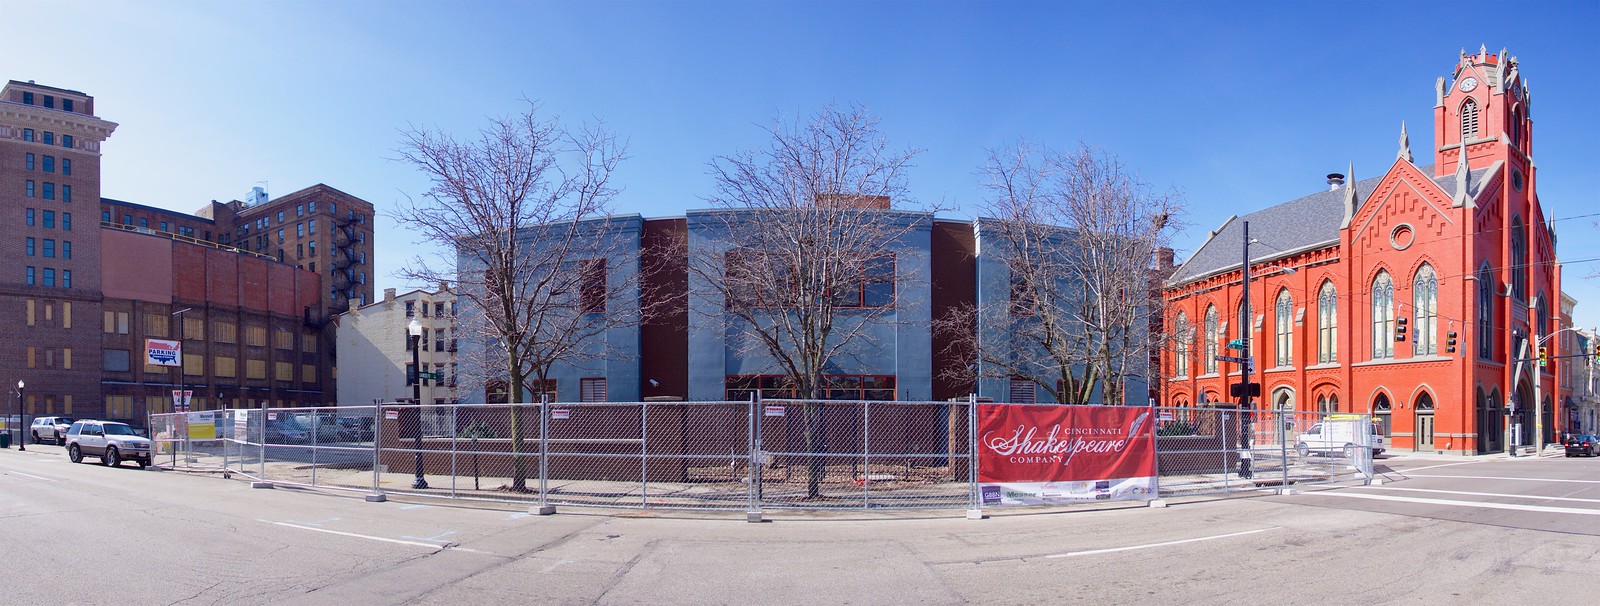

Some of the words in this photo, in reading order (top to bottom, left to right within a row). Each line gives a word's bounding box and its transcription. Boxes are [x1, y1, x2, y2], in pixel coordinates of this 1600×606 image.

[1064, 427, 1122, 435] CINCINNATI
[983, 424, 1127, 466] Shakespeare
[1009, 456, 1064, 464] COMPANY
